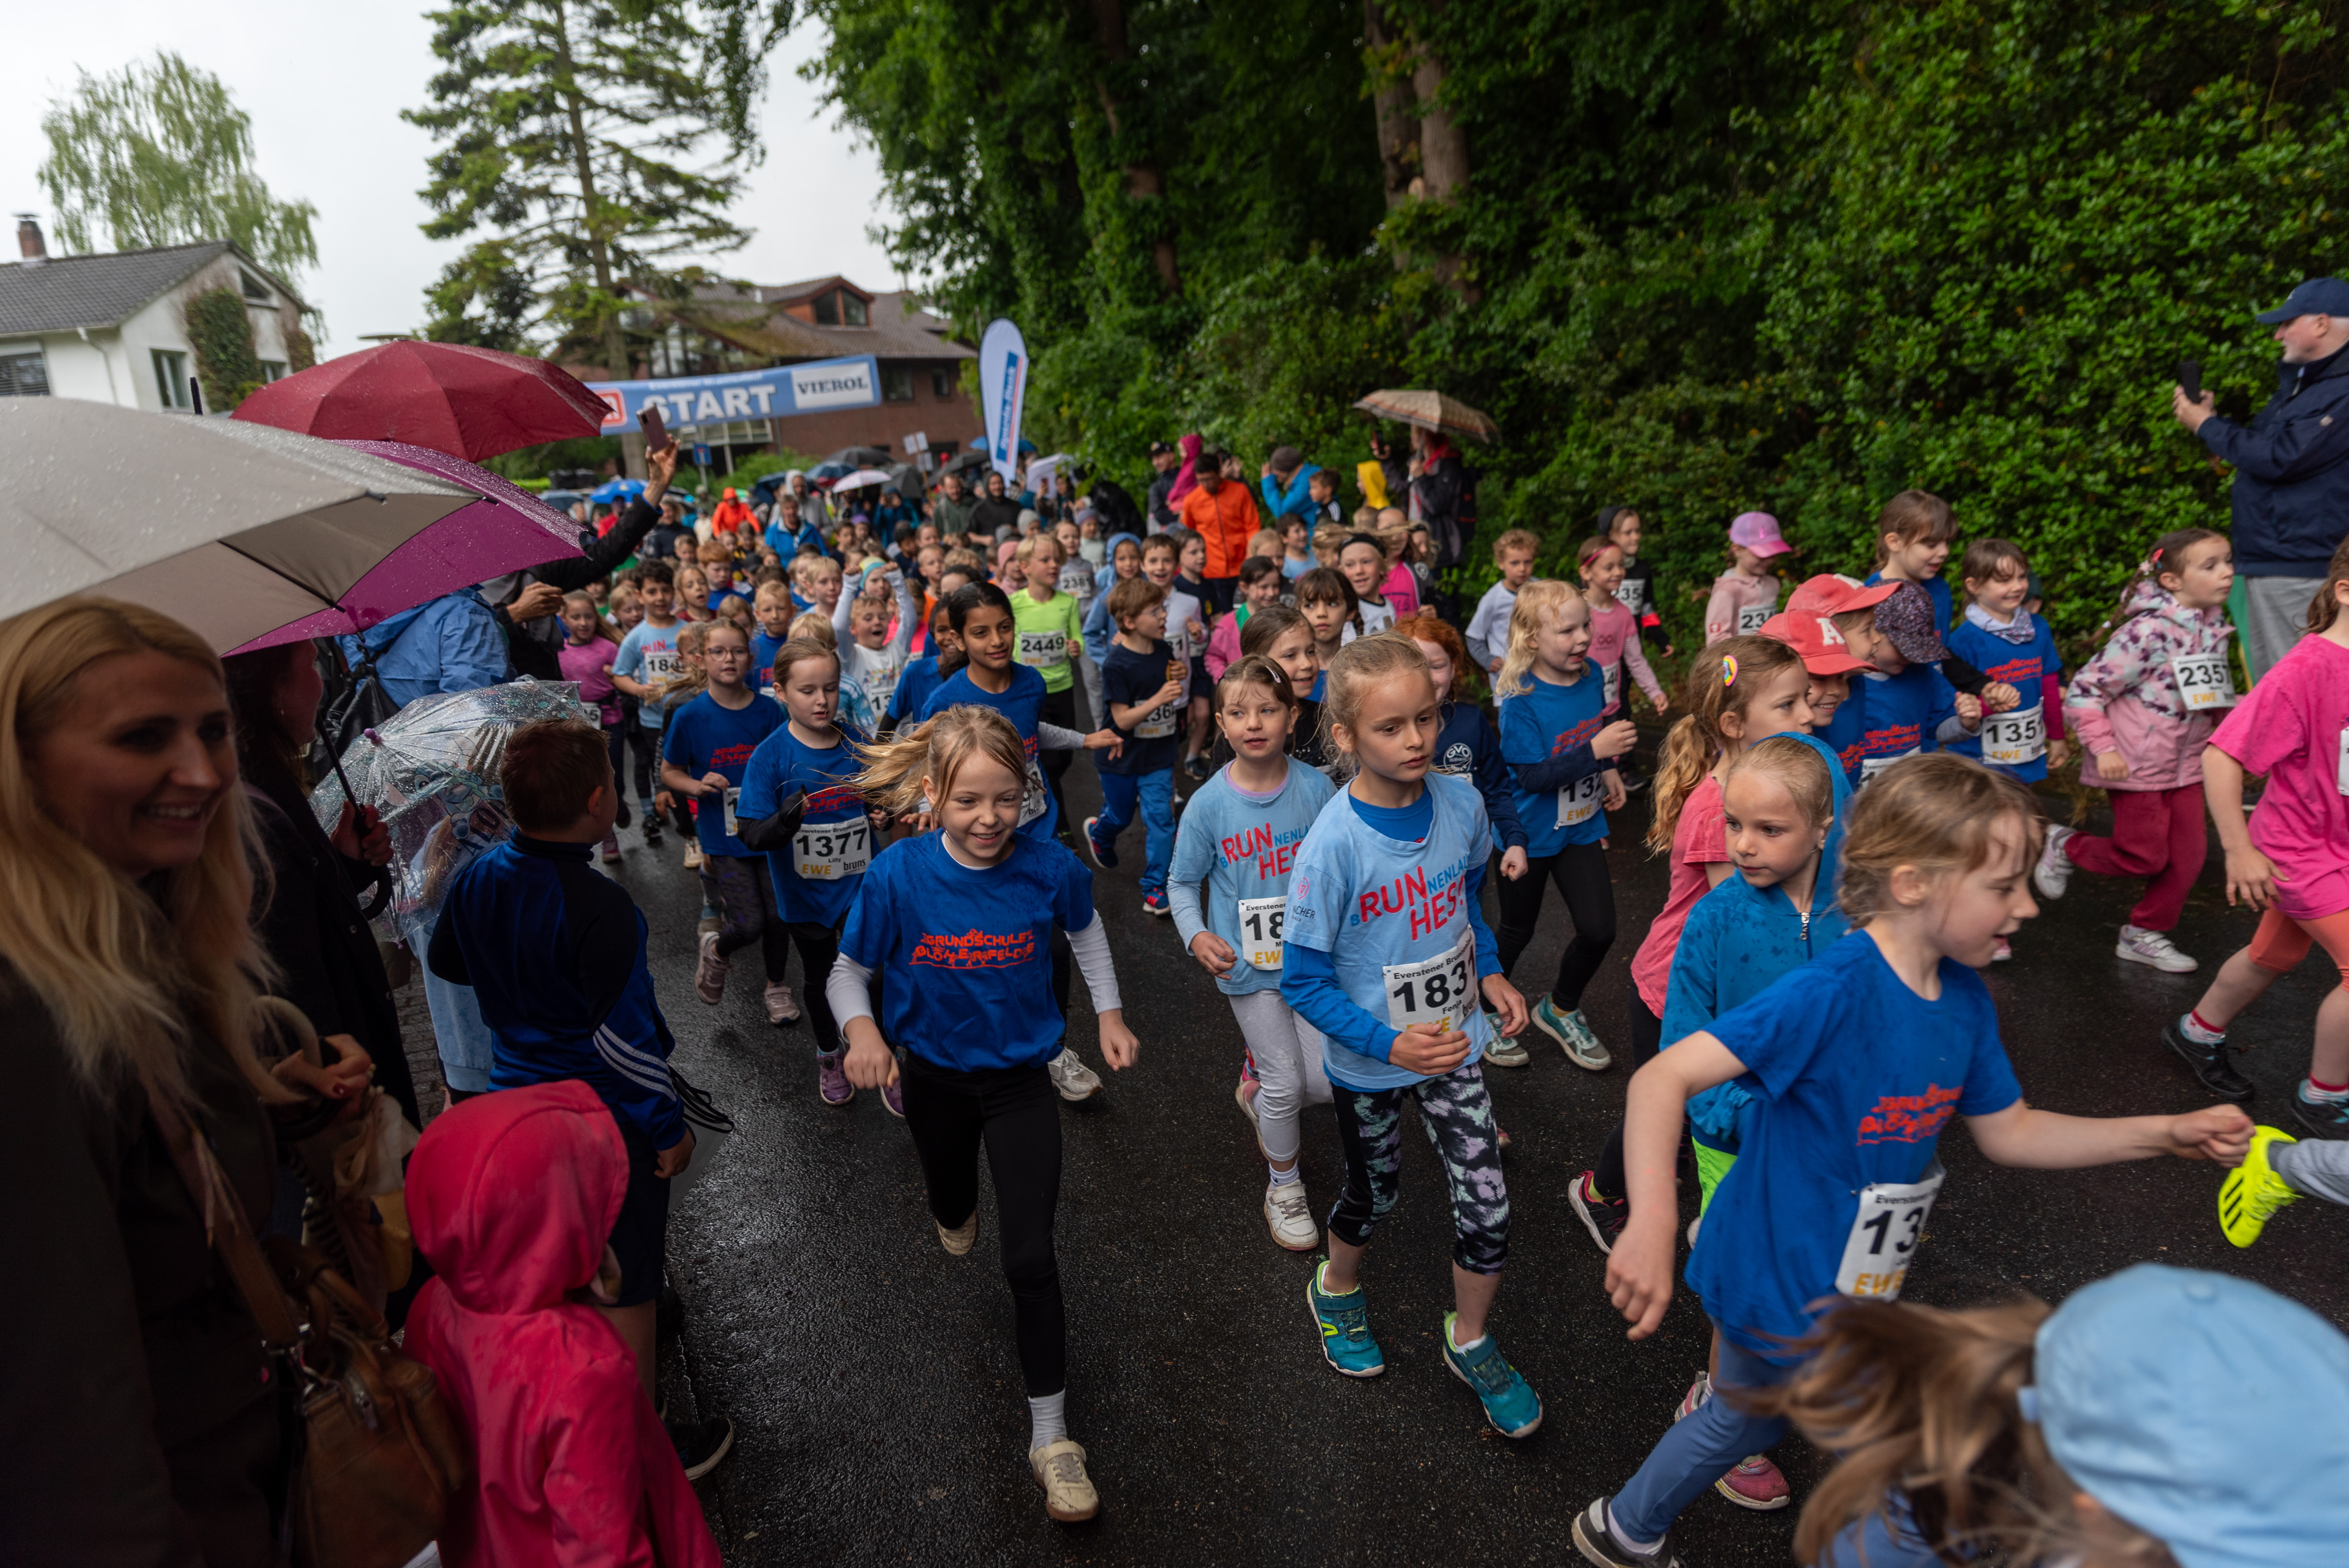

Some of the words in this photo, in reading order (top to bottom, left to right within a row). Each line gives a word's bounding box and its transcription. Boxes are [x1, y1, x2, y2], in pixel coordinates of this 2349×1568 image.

[798, 376, 868, 395] VIEROL
[643, 384, 777, 424] START
[1817, 617, 1845, 645] A
[1022, 636, 1064, 652] 2449
[2193, 692, 2217, 704] EWE
[1446, 745, 1469, 758] GVO
[1992, 750, 2021, 759] EWE
[1567, 804, 1592, 821] EWE
[797, 827, 868, 857] 1377
[802, 864, 832, 875] EWE
[844, 859, 865, 871] bruns
[927, 934, 1027, 947] GRUNDSCHULE
[1255, 950, 1283, 965] EW
[1393, 945, 1475, 1012] 1831
[1394, 963, 1444, 979] Everstener
